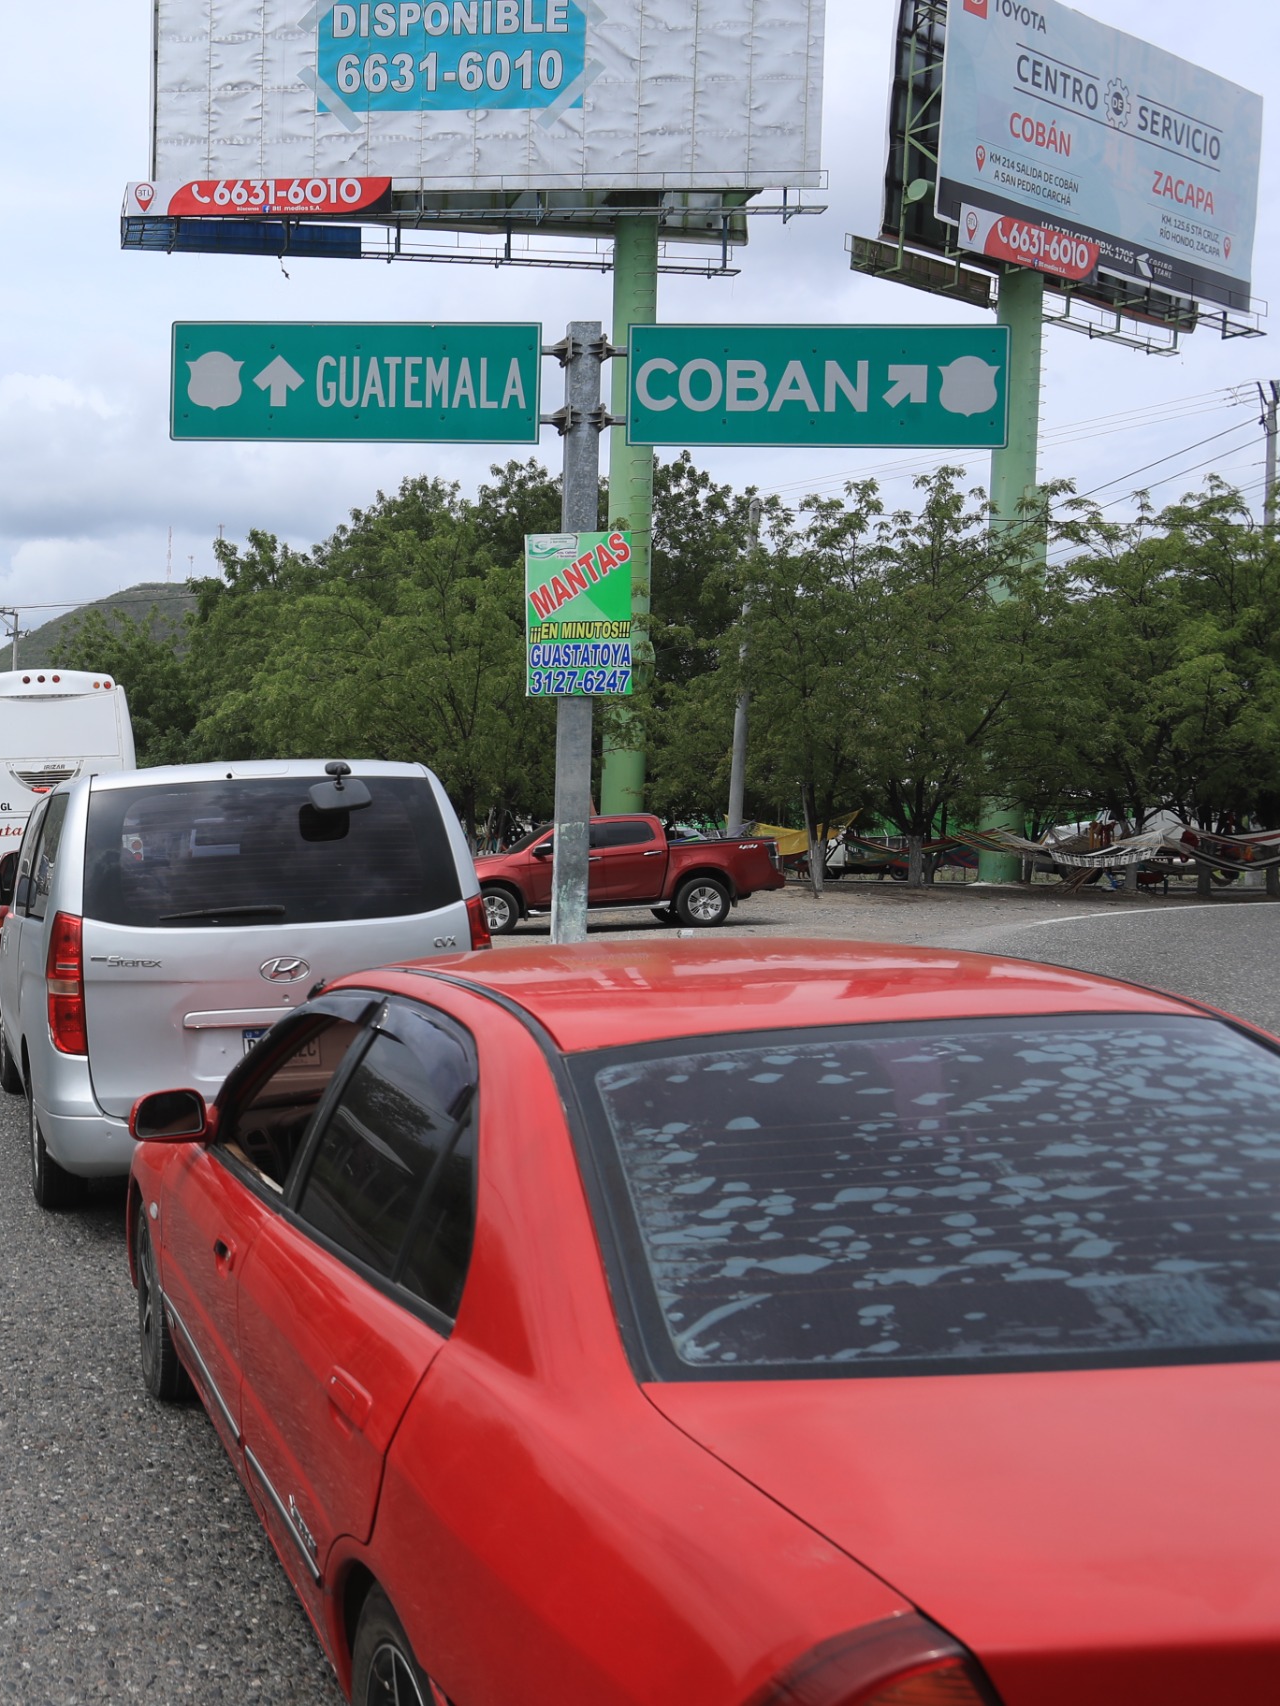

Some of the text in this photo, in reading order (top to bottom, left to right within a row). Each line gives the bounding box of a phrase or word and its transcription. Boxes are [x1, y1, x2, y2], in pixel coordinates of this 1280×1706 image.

[332, 0, 569, 38] DISPONIBLE
[995, 0, 1047, 35] TOYOTA
[336, 49, 563, 94] 6631-6010
[1016, 54, 1221, 161] CENTRO DE SERVICIO
[1009, 111, 1071, 158] COBÁN
[989, 151, 1079, 194] KM 214 SALIDA DE COBÁN
[993, 169, 1071, 206] A SAN PEDRO CARCHÁ
[213, 178, 362, 206] 6631-6010
[1152, 169, 1214, 216] ZACAPA
[1009, 223, 1089, 269] 6631-6010
[1190, 224, 1202, 235] STA
[1195, 241, 1220, 258] ZACAPA
[316, 355, 526, 409] GUATEMALA
[635, 358, 869, 412] COBAN
[529, 533, 631, 620] MANTAS
[561, 621, 630, 639] MINUTOS!!!
[530, 644, 631, 667] GUASTATOYA
[530, 670, 630, 694] 3127-6247
[107, 955, 162, 969] Starex
